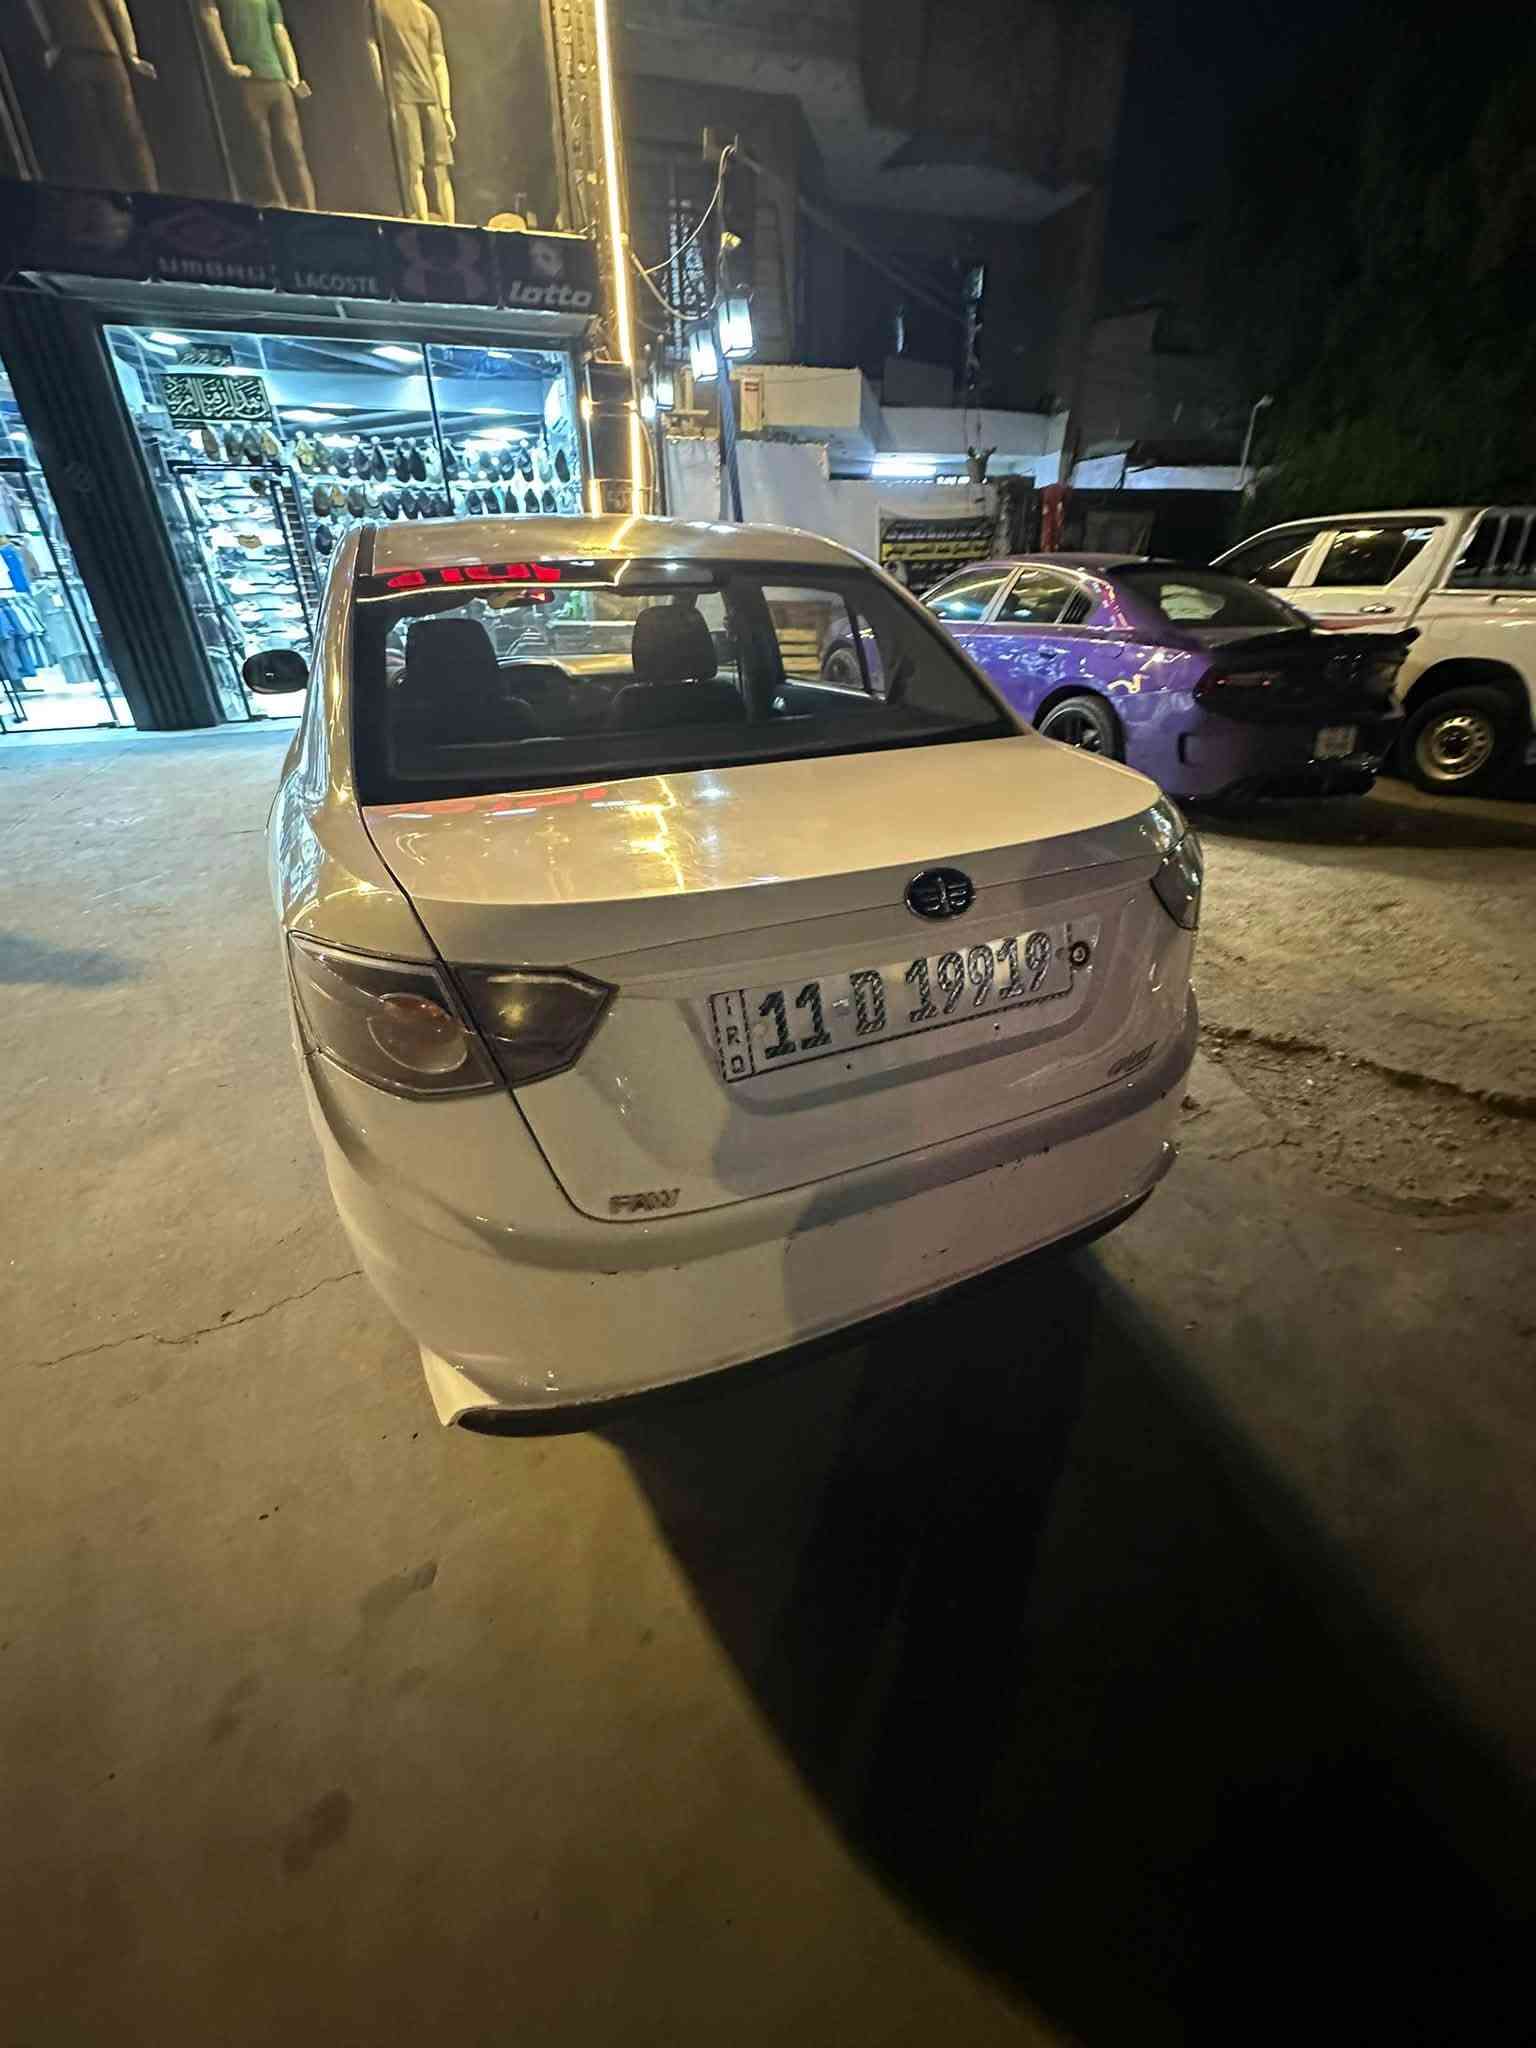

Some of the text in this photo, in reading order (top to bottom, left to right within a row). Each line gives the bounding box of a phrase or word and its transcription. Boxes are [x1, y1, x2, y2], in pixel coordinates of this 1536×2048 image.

[294, 271, 380, 294] LACOSTE
[758, 981, 832, 1060] 11
[904, 930, 1051, 1023] 19919
